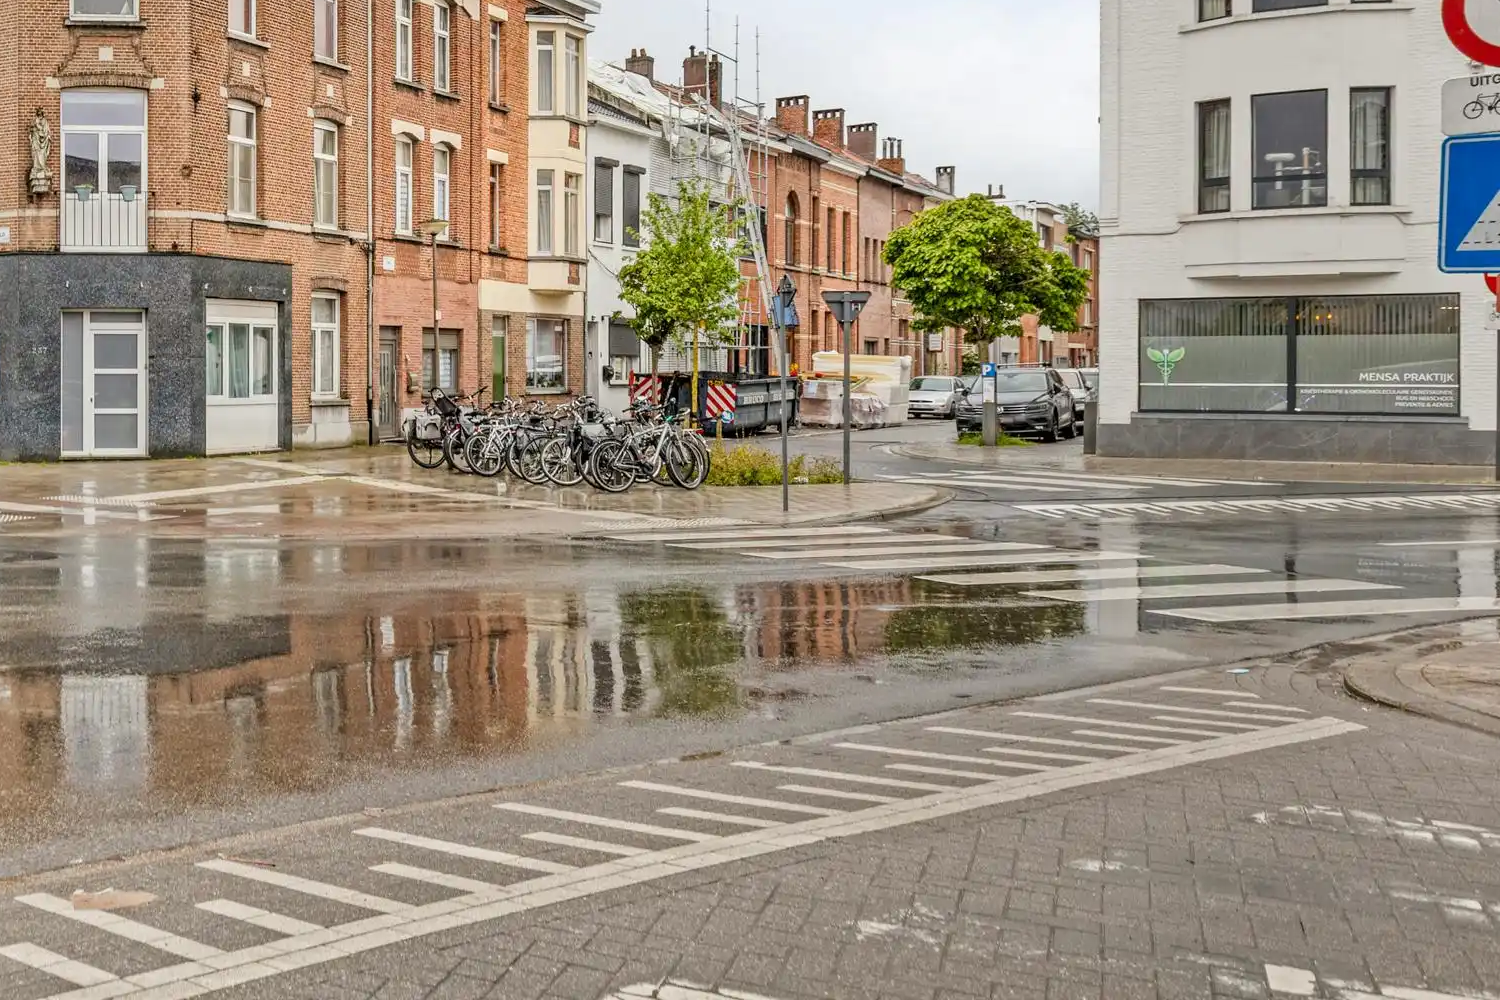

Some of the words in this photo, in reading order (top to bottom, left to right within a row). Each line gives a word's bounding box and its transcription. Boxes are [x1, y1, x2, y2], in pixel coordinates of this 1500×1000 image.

[982, 364, 992, 376] P
[1359, 372, 1400, 382] MENSA
[1403, 372, 1455, 384] PRAKTIJK
